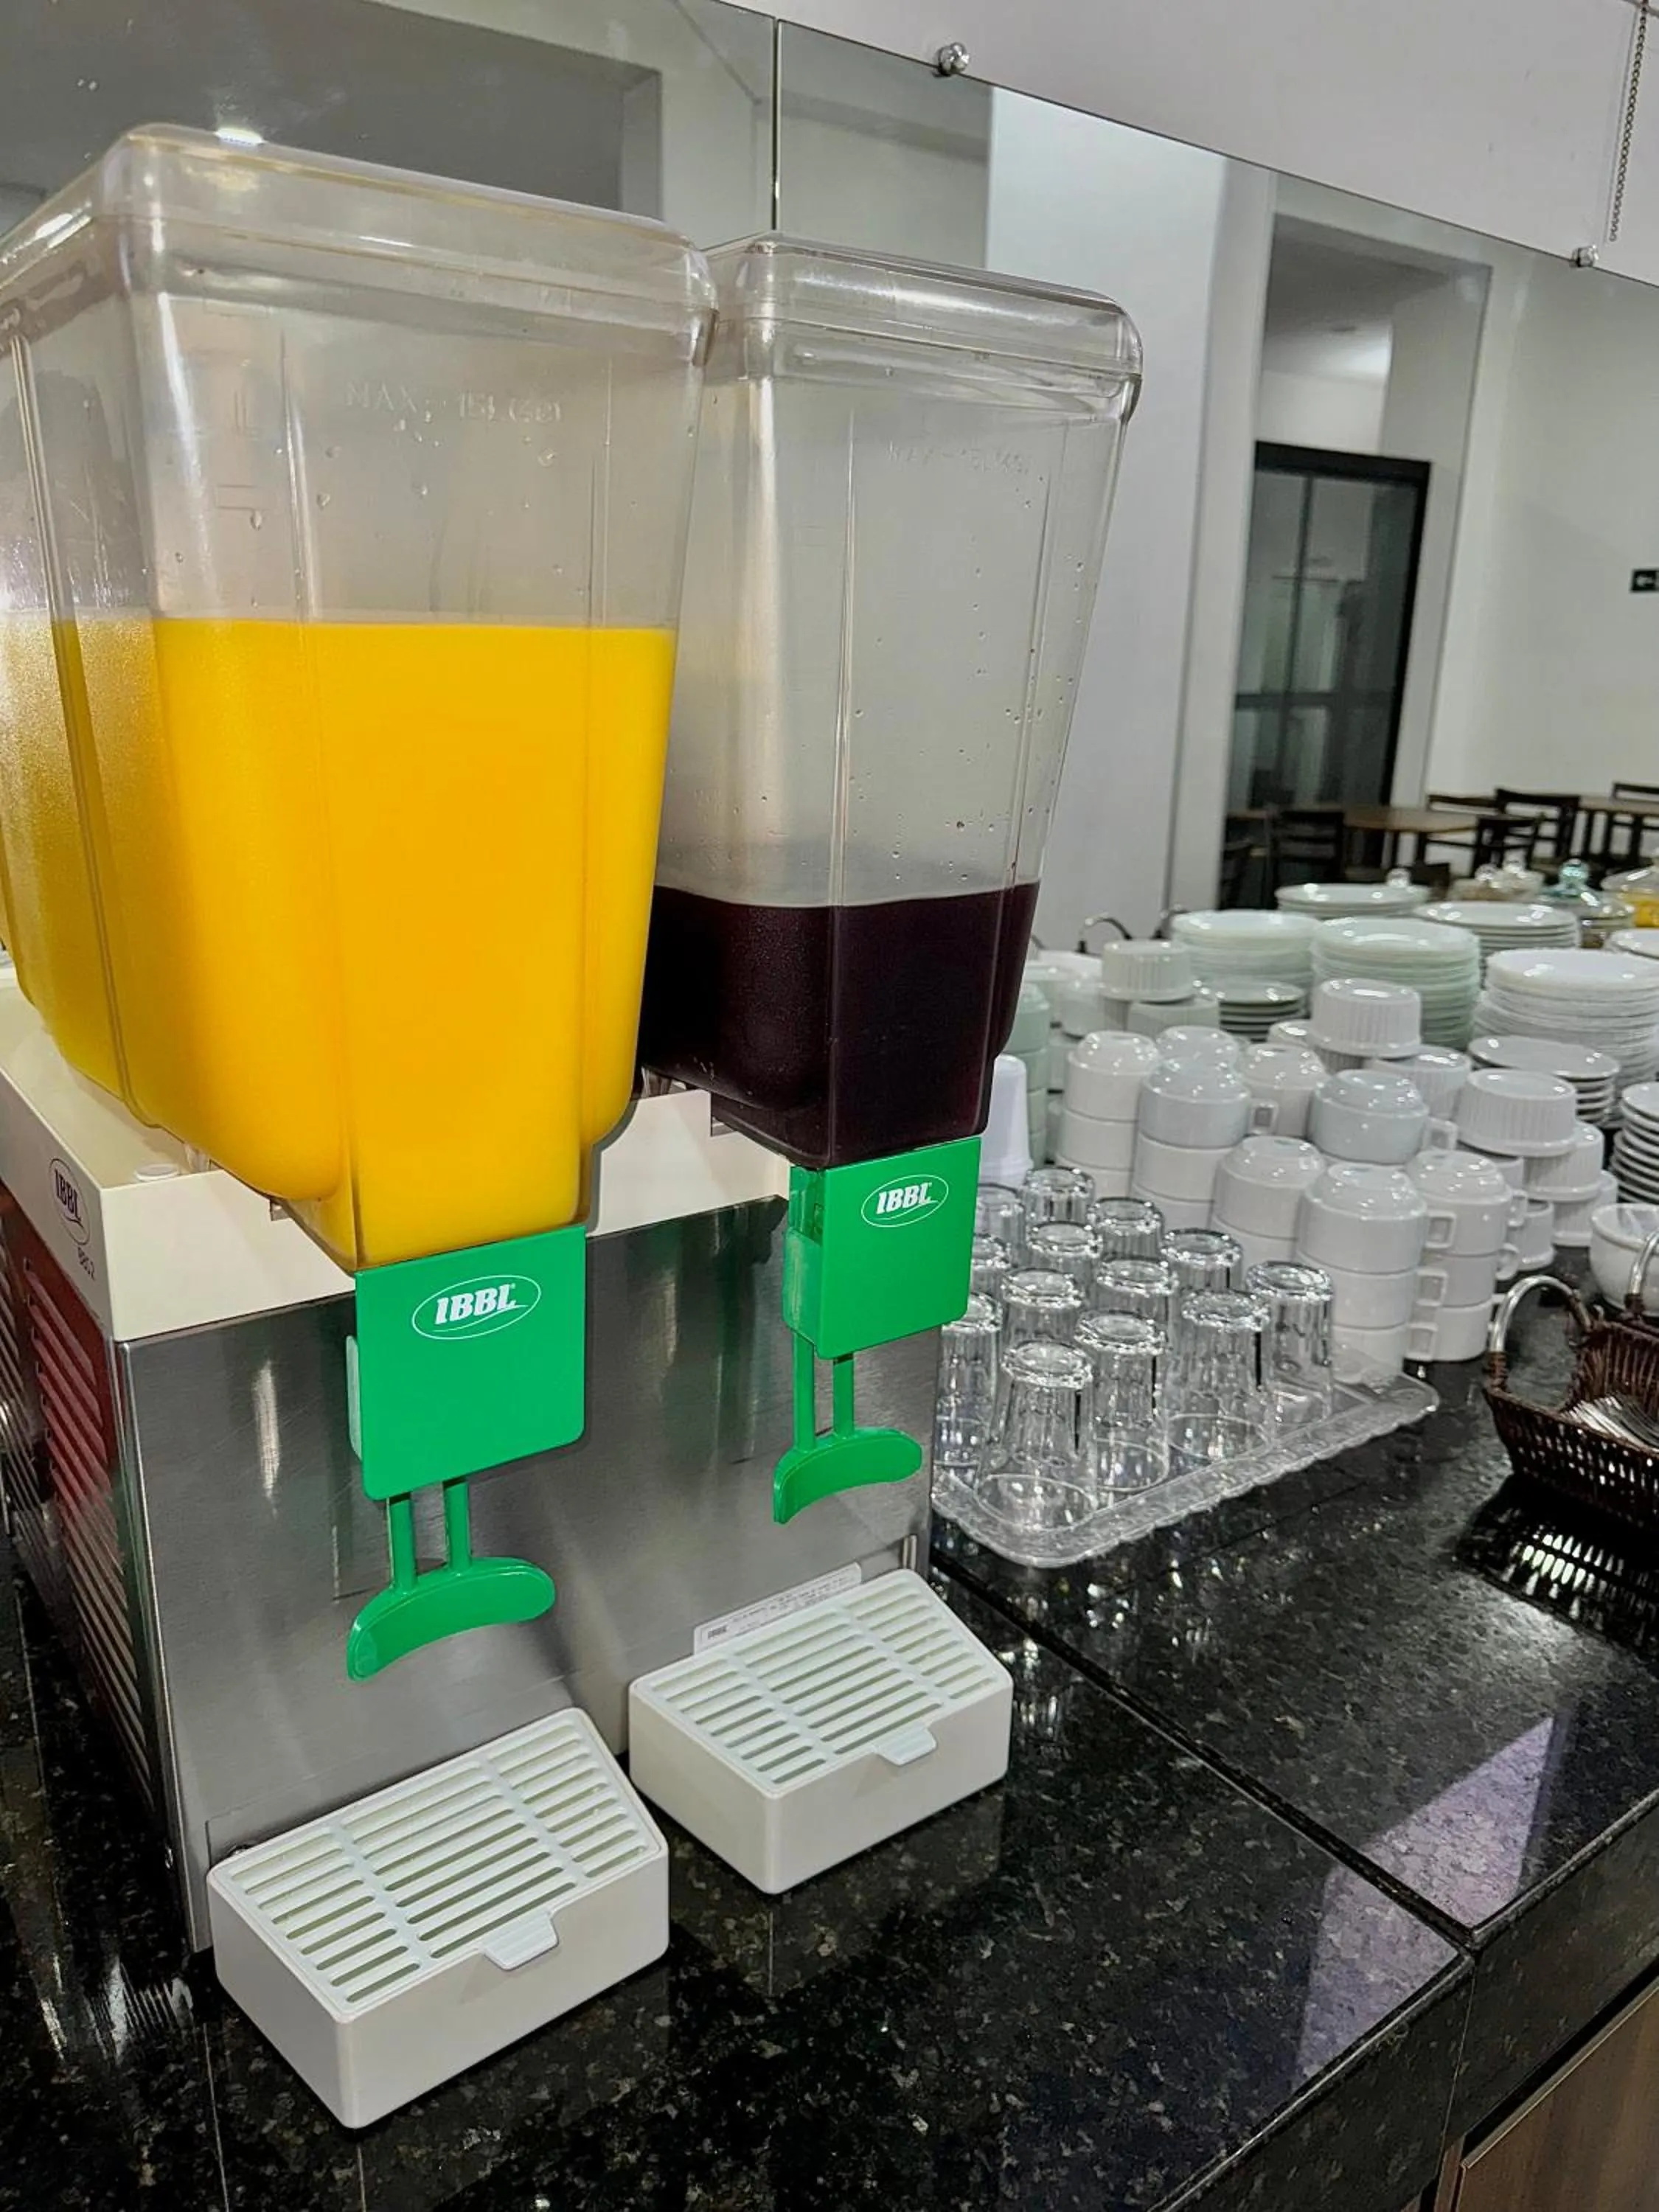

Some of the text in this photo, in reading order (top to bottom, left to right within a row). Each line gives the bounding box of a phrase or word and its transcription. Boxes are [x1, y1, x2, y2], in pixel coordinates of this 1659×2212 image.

[53, 1168, 82, 1222] IBBL
[875, 1182, 933, 1215] IBBL
[434, 1283, 516, 1325] IBBL
